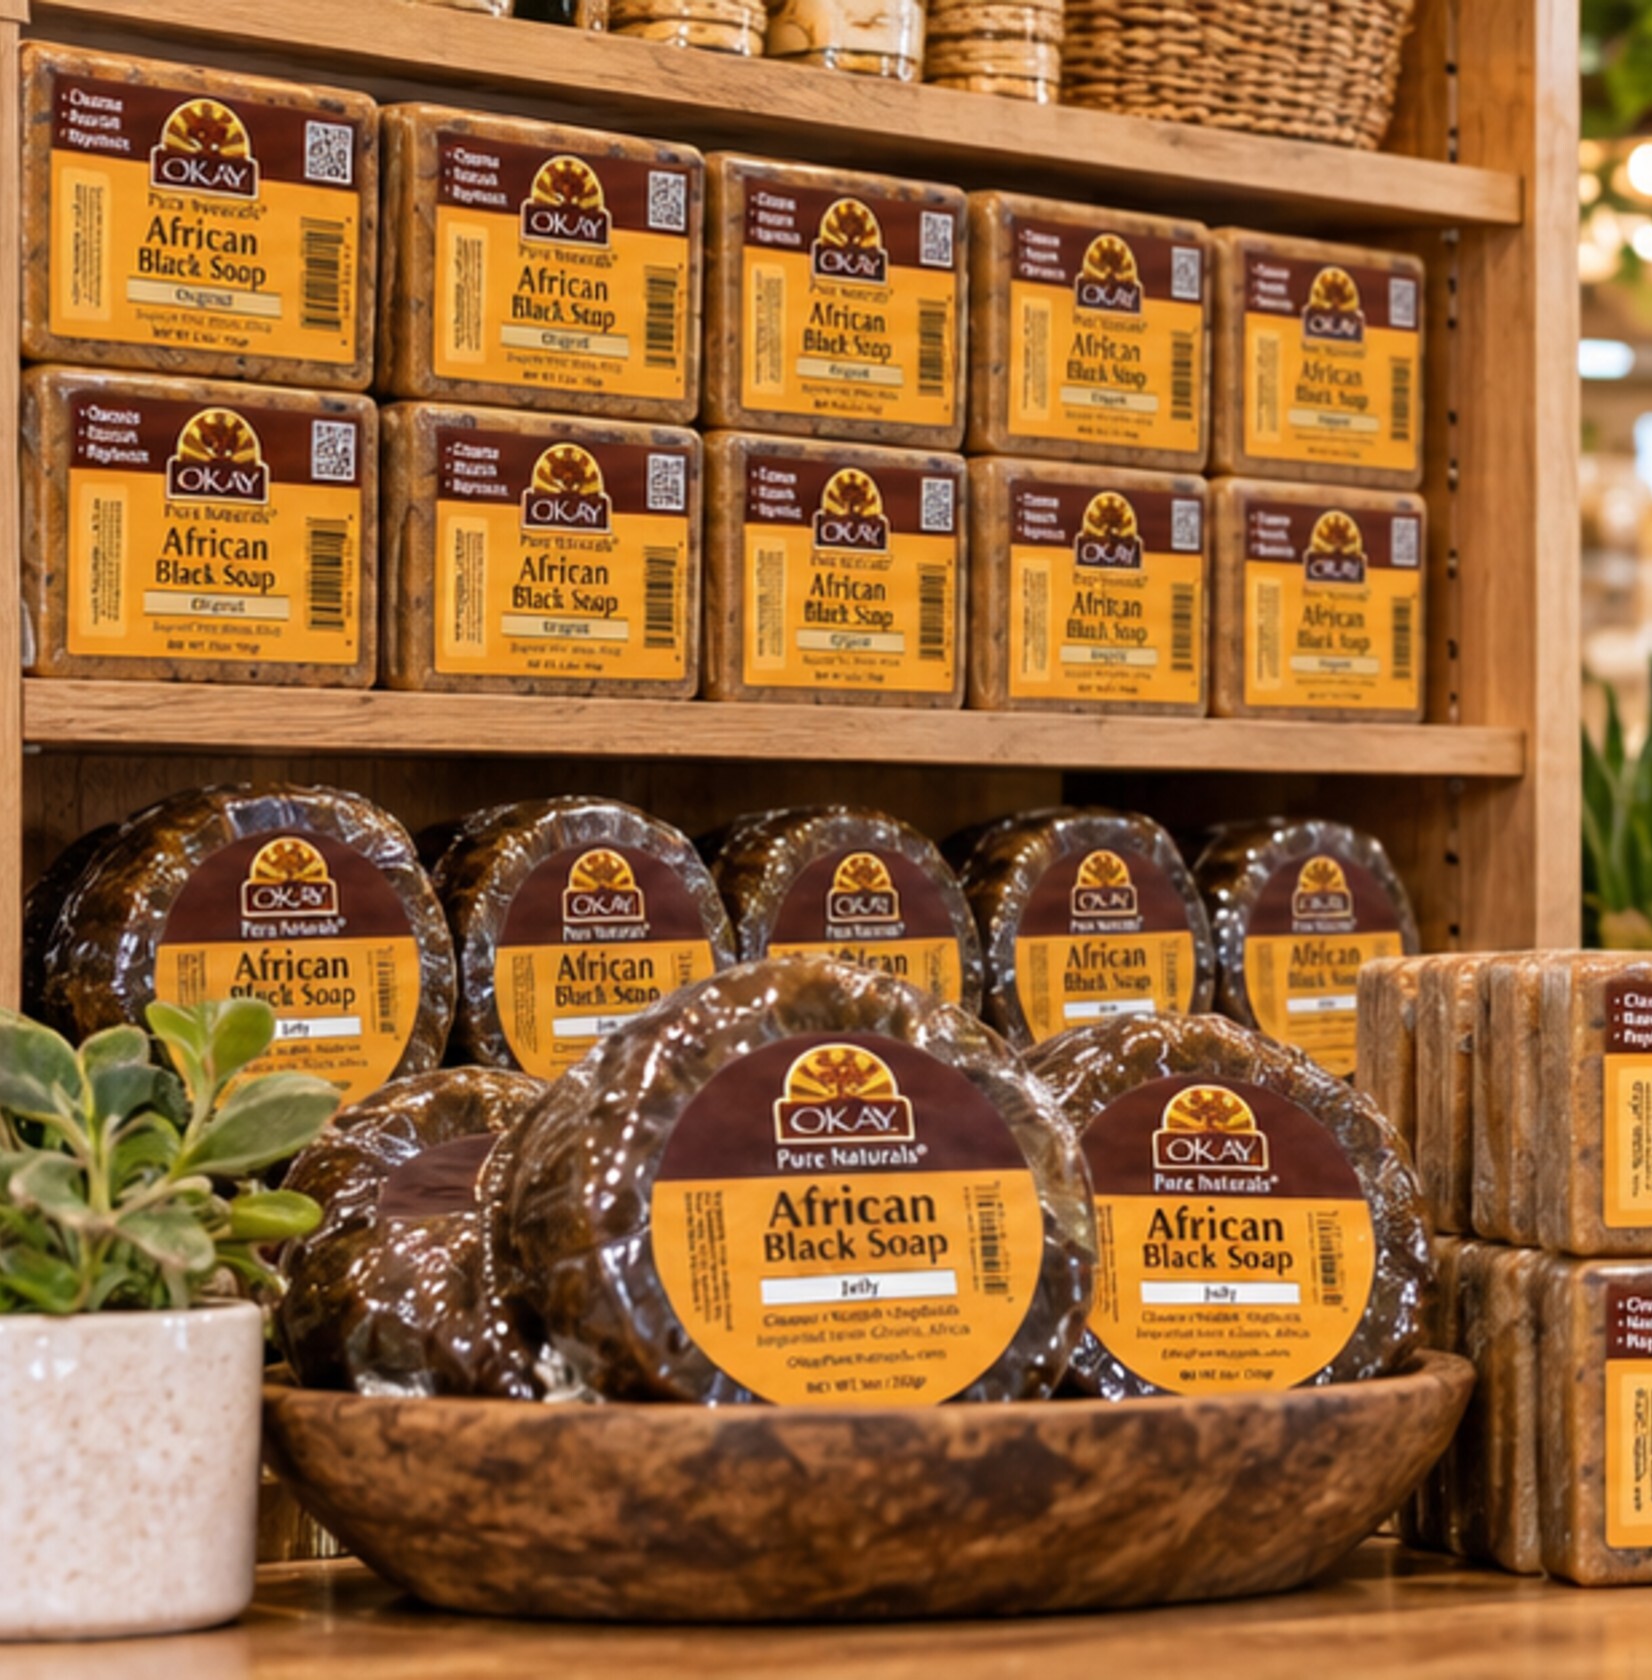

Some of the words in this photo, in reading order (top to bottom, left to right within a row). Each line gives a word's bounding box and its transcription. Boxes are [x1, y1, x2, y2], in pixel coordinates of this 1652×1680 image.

[162, 158, 247, 187] OKAY
[146, 216, 257, 255] African
[139, 248, 200, 277] Black
[517, 266, 608, 302] African
[810, 302, 885, 332] African
[178, 467, 259, 494] OKAY
[163, 527, 268, 561] African
[156, 560, 215, 585] Black
[520, 555, 608, 585] African
[513, 585, 564, 610] Black
[810, 573, 886, 601] African
[234, 949, 349, 981] African
[558, 951, 654, 982] African
[1067, 942, 1146, 969] African
[302, 984, 355, 1010] Soap
[790, 1106, 897, 1133] OKAY
[777, 1148, 824, 1169] Pure
[1166, 1137, 1255, 1163] OKAY
[769, 1186, 936, 1228] African
[1148, 1205, 1284, 1242] African
[764, 1231, 857, 1263] Black
[867, 1229, 948, 1264] Soap
[1143, 1243, 1216, 1269] Black
[1228, 1245, 1293, 1276] Soap
